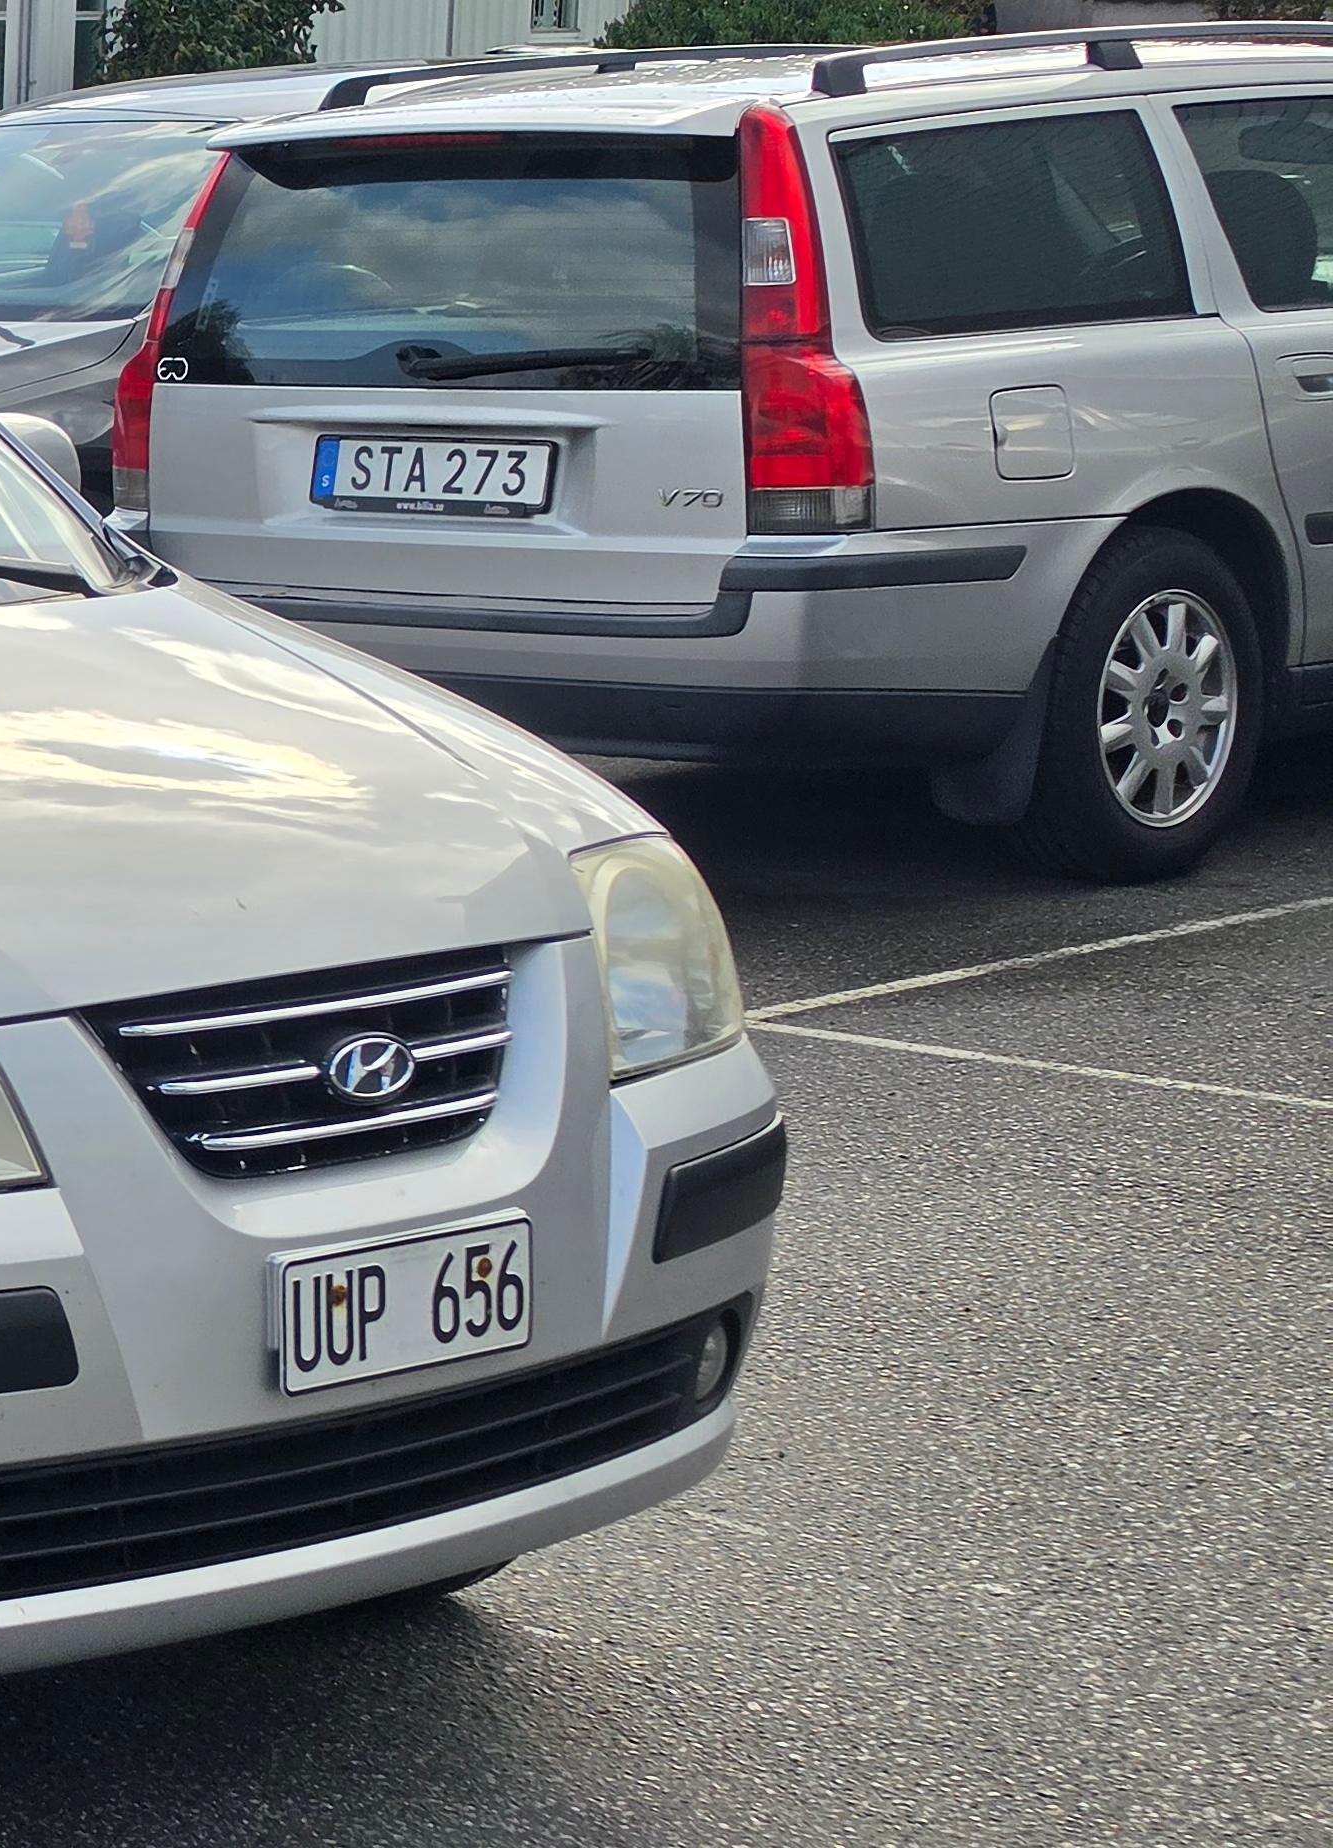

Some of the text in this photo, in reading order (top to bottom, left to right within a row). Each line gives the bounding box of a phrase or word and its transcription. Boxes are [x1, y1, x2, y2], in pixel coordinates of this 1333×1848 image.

[321, 474, 330, 487] S
[351, 445, 528, 497] STA 273
[657, 487, 724, 508] V70
[292, 1239, 524, 1373] UUP 656
